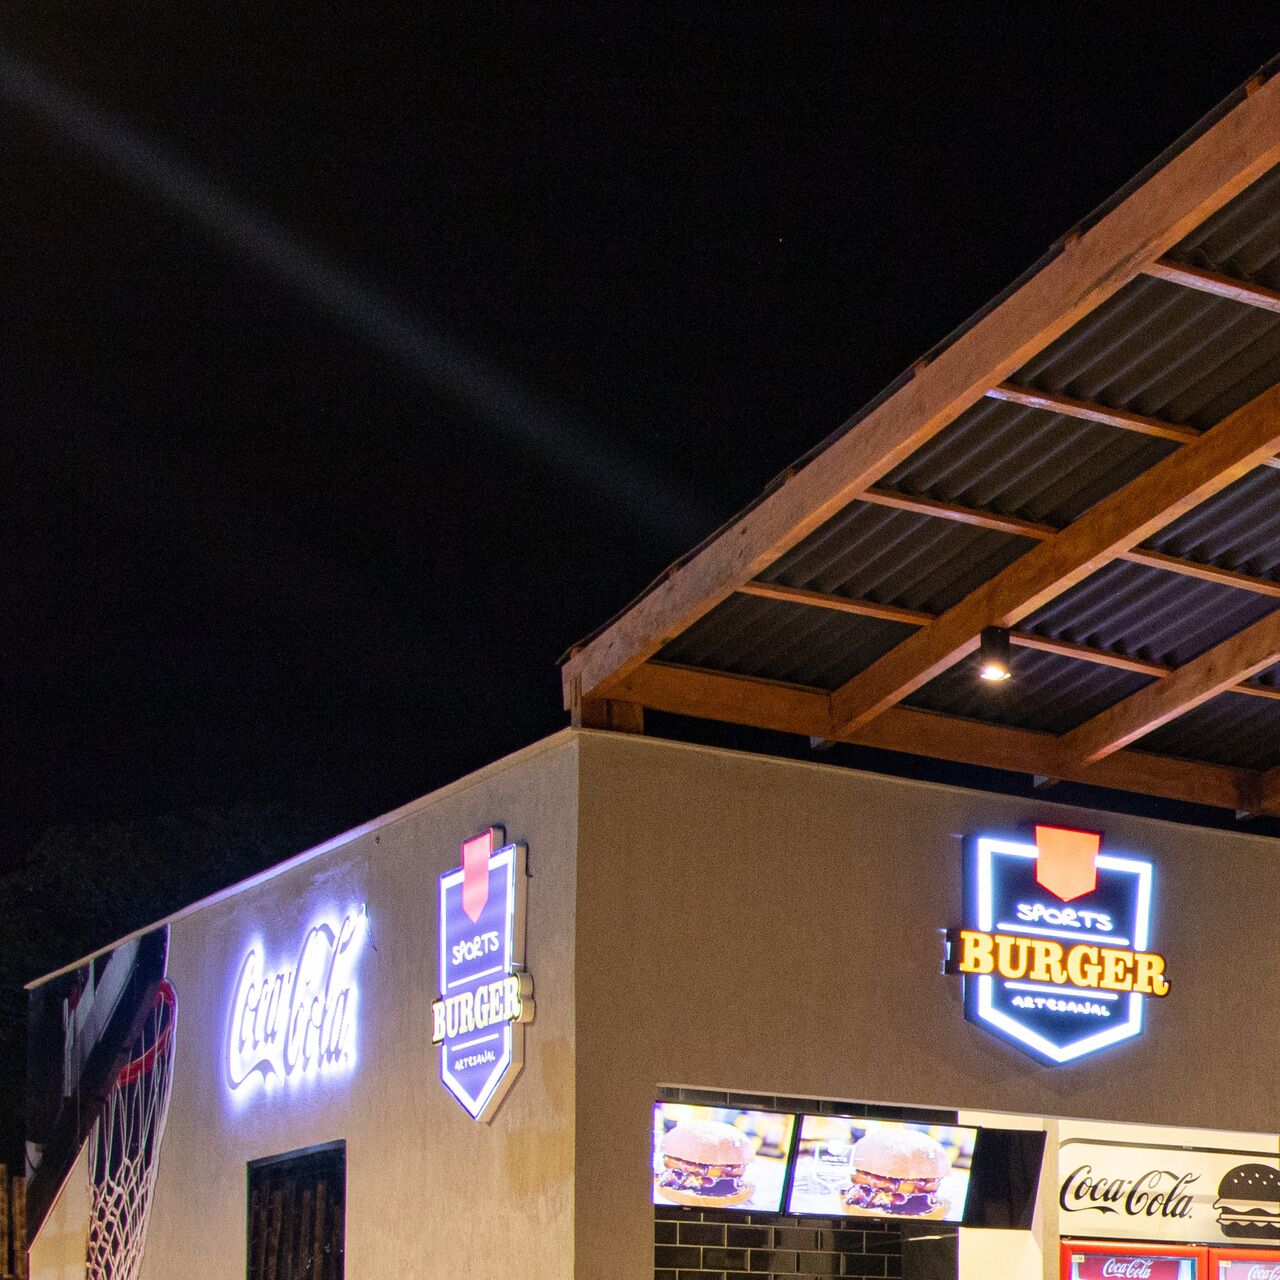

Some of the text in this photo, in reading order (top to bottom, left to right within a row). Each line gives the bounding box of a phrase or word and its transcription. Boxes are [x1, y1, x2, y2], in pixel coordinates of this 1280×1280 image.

[1017, 903, 1114, 932] SPORTS
[451, 931, 500, 966] SPORTS
[959, 929, 1170, 997] BURGER
[226, 902, 367, 1091] Coca-Cola
[431, 974, 521, 1044] BURGER
[1011, 996, 1111, 1017] ARTESANAL
[454, 1049, 496, 1071] ARTESANAL
[1058, 1164, 1202, 1219] Coca-Cola
[1102, 1258, 1152, 1280] Coca-Cola
